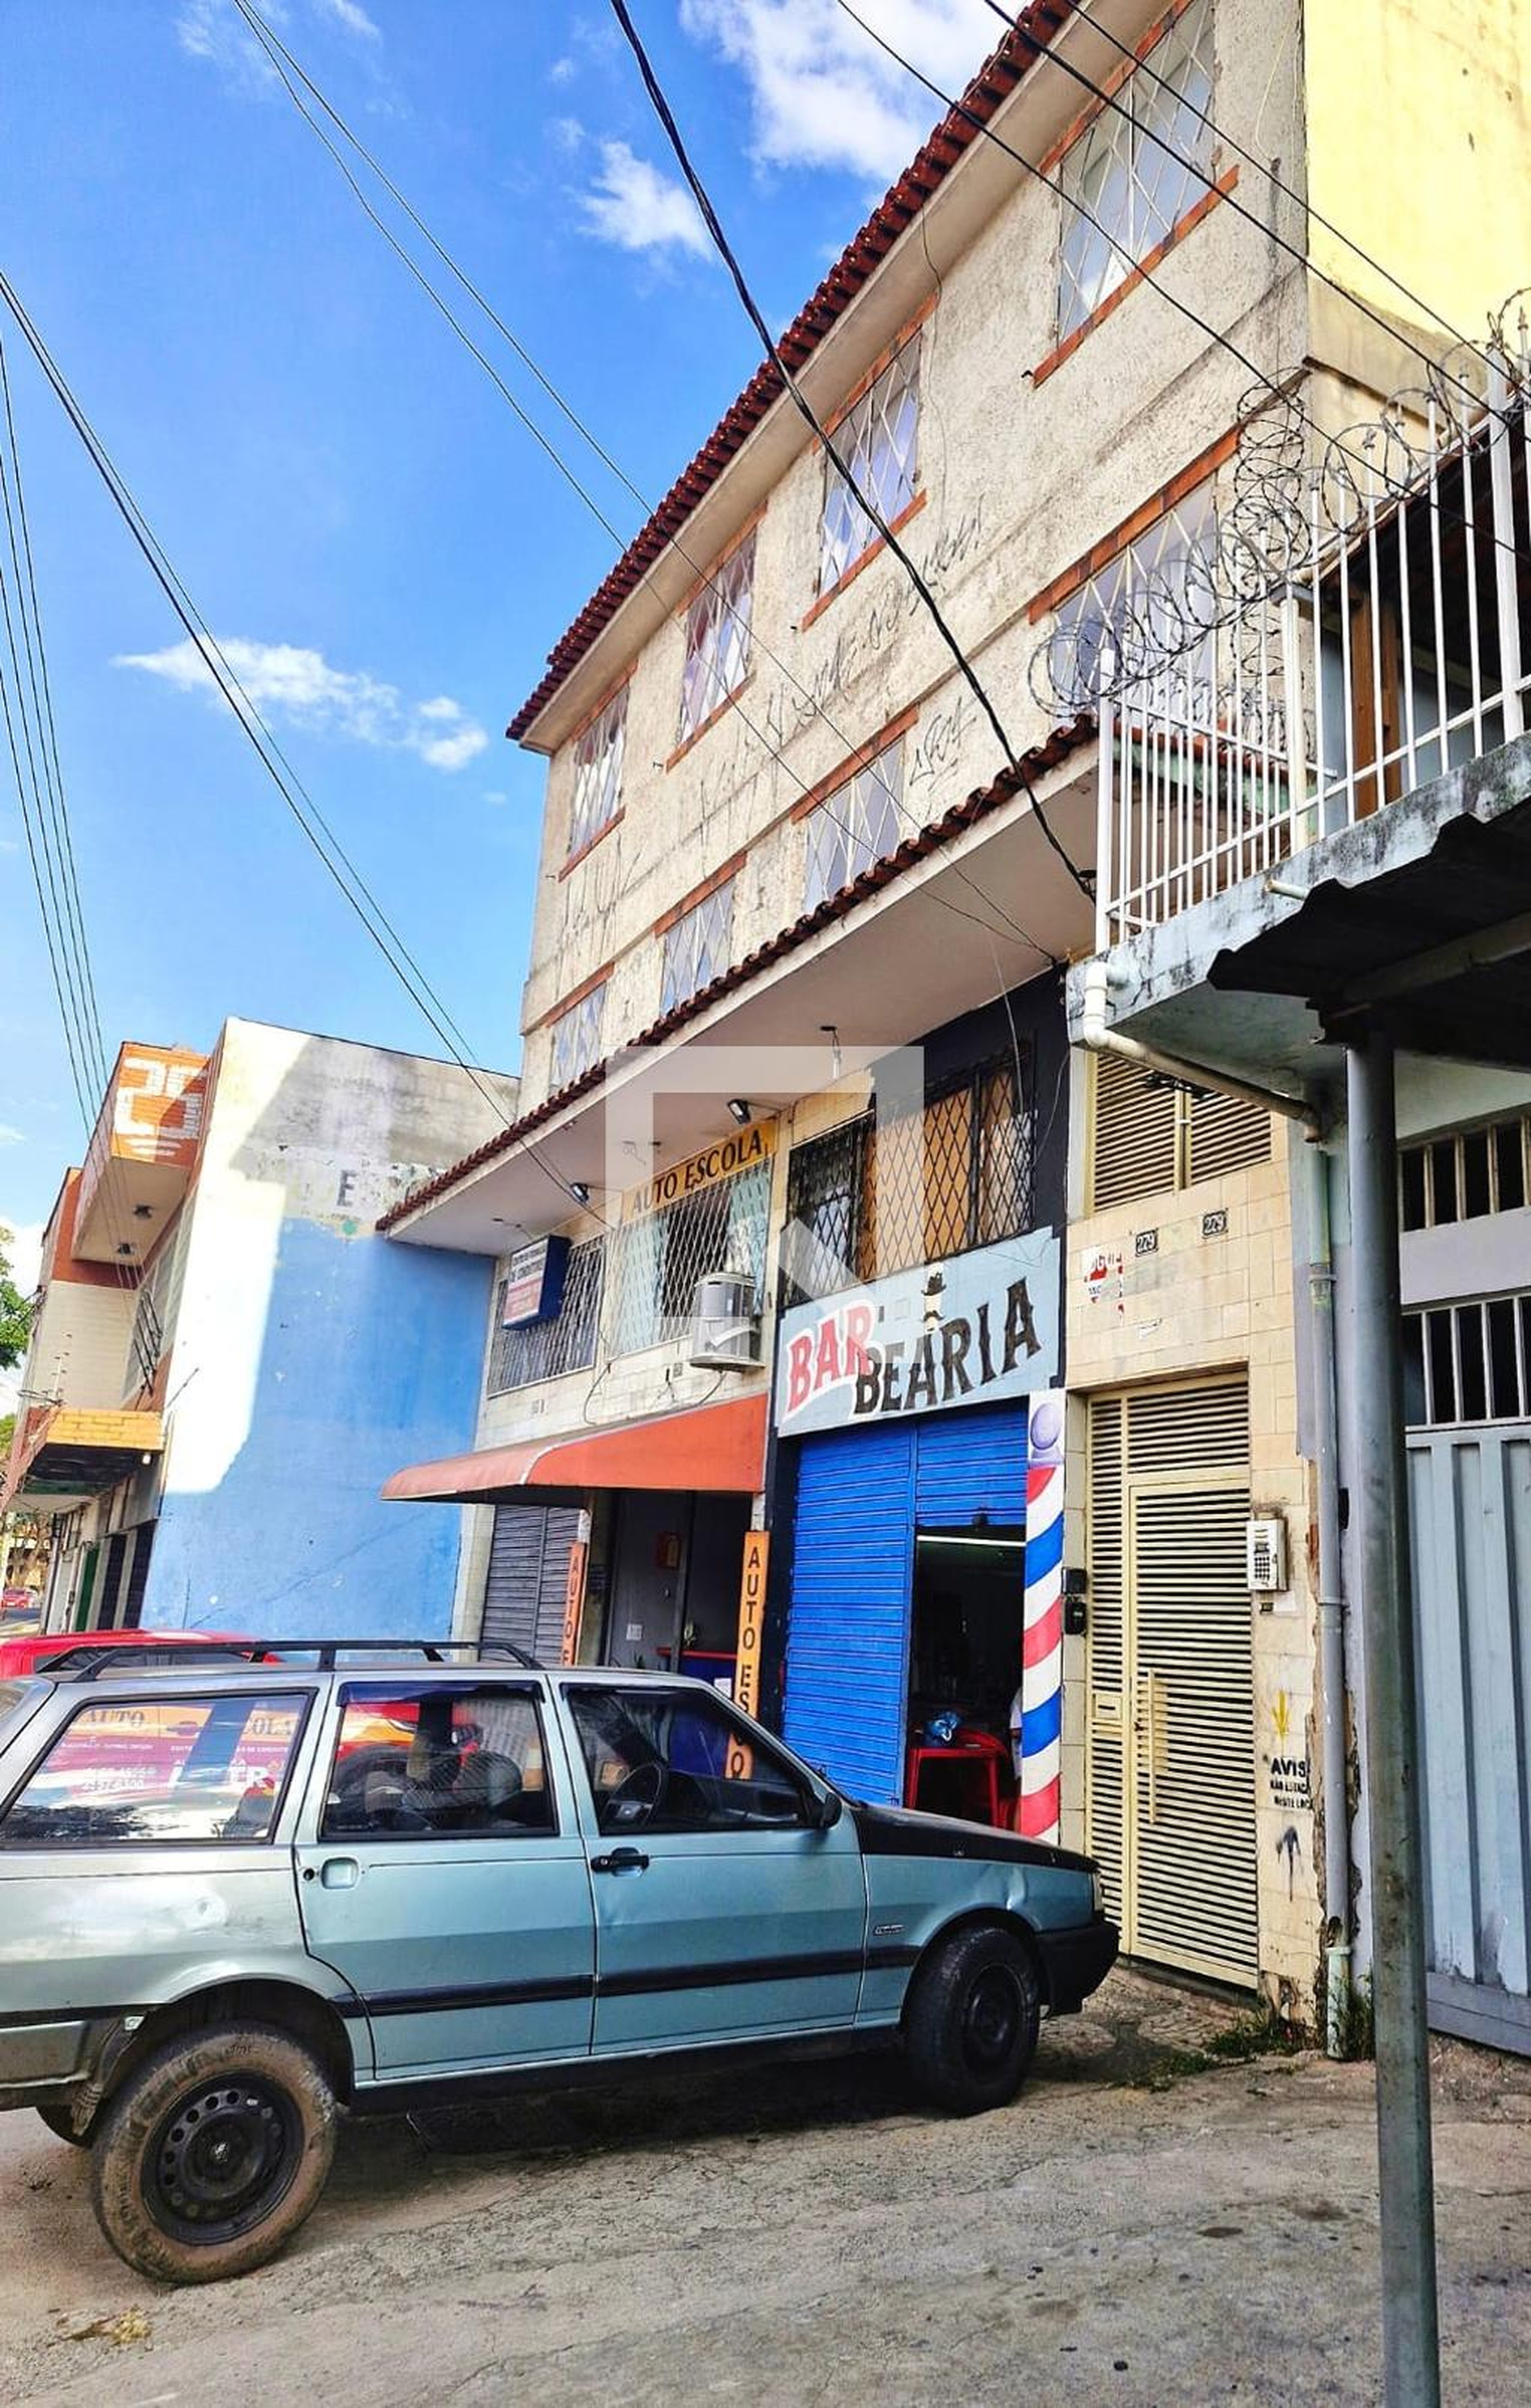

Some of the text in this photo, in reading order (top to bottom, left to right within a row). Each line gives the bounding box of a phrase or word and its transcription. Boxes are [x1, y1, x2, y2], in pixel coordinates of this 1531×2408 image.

[633, 1129, 762, 1213] AUTO ESCOLA
[742, 1546, 760, 1650] AUTO
[1271, 1758, 1311, 1777] AVIS
